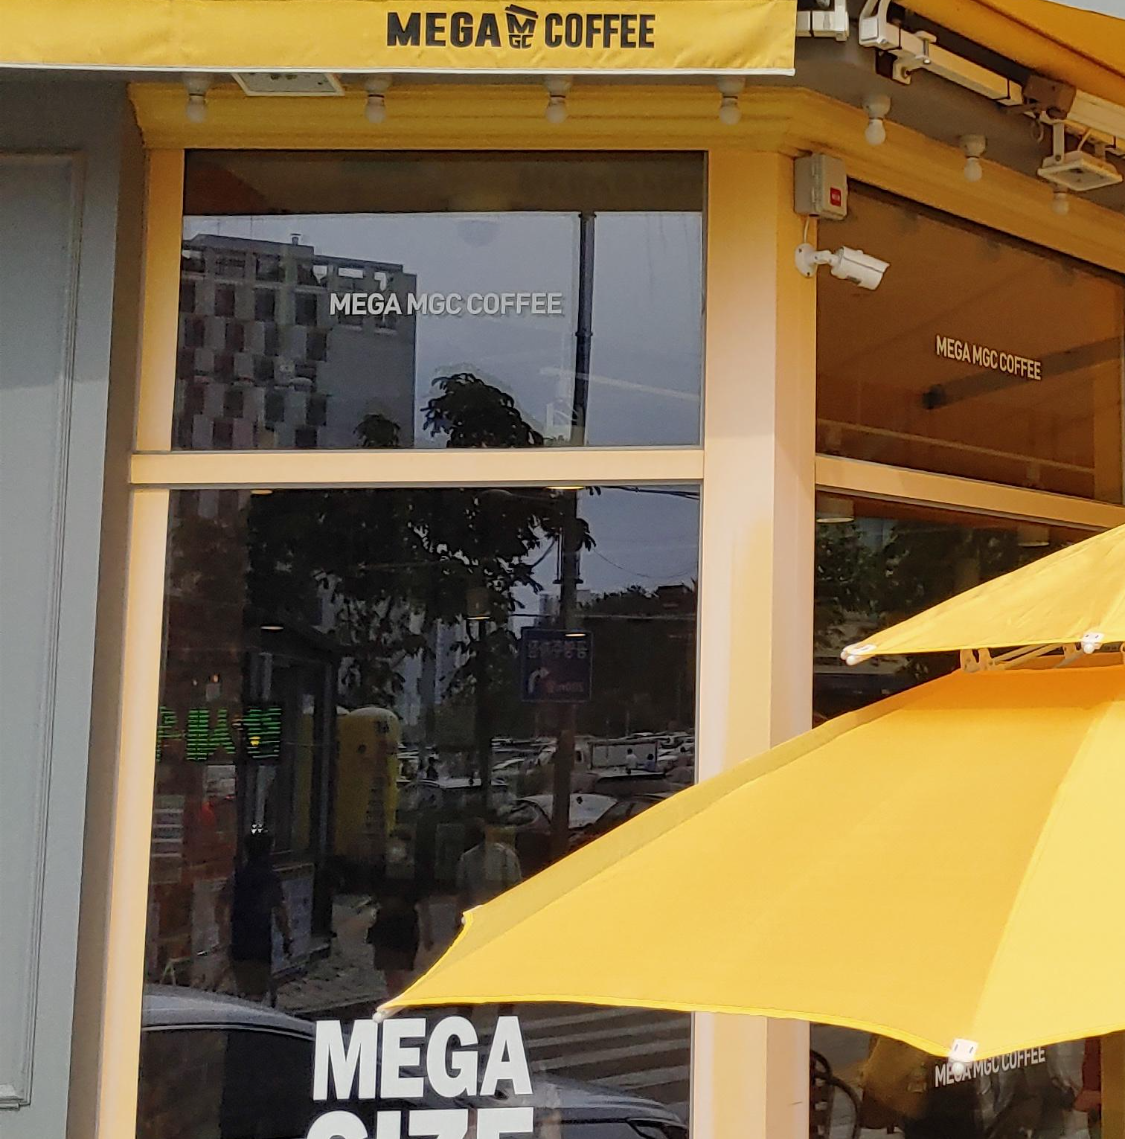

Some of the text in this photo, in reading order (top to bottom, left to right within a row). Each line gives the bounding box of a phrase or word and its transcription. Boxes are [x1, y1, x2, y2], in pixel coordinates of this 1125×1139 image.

[386, 11, 656, 49] MEGA COFFEE
[329, 292, 563, 315] MEGA MGC COFFEE
[936, 335, 1042, 380] MEGA MGC COFFEE
[312, 1015, 533, 1101] MEGA
[973, 1056, 999, 1079] MGC
[1001, 1046, 1046, 1071] COFFEE
